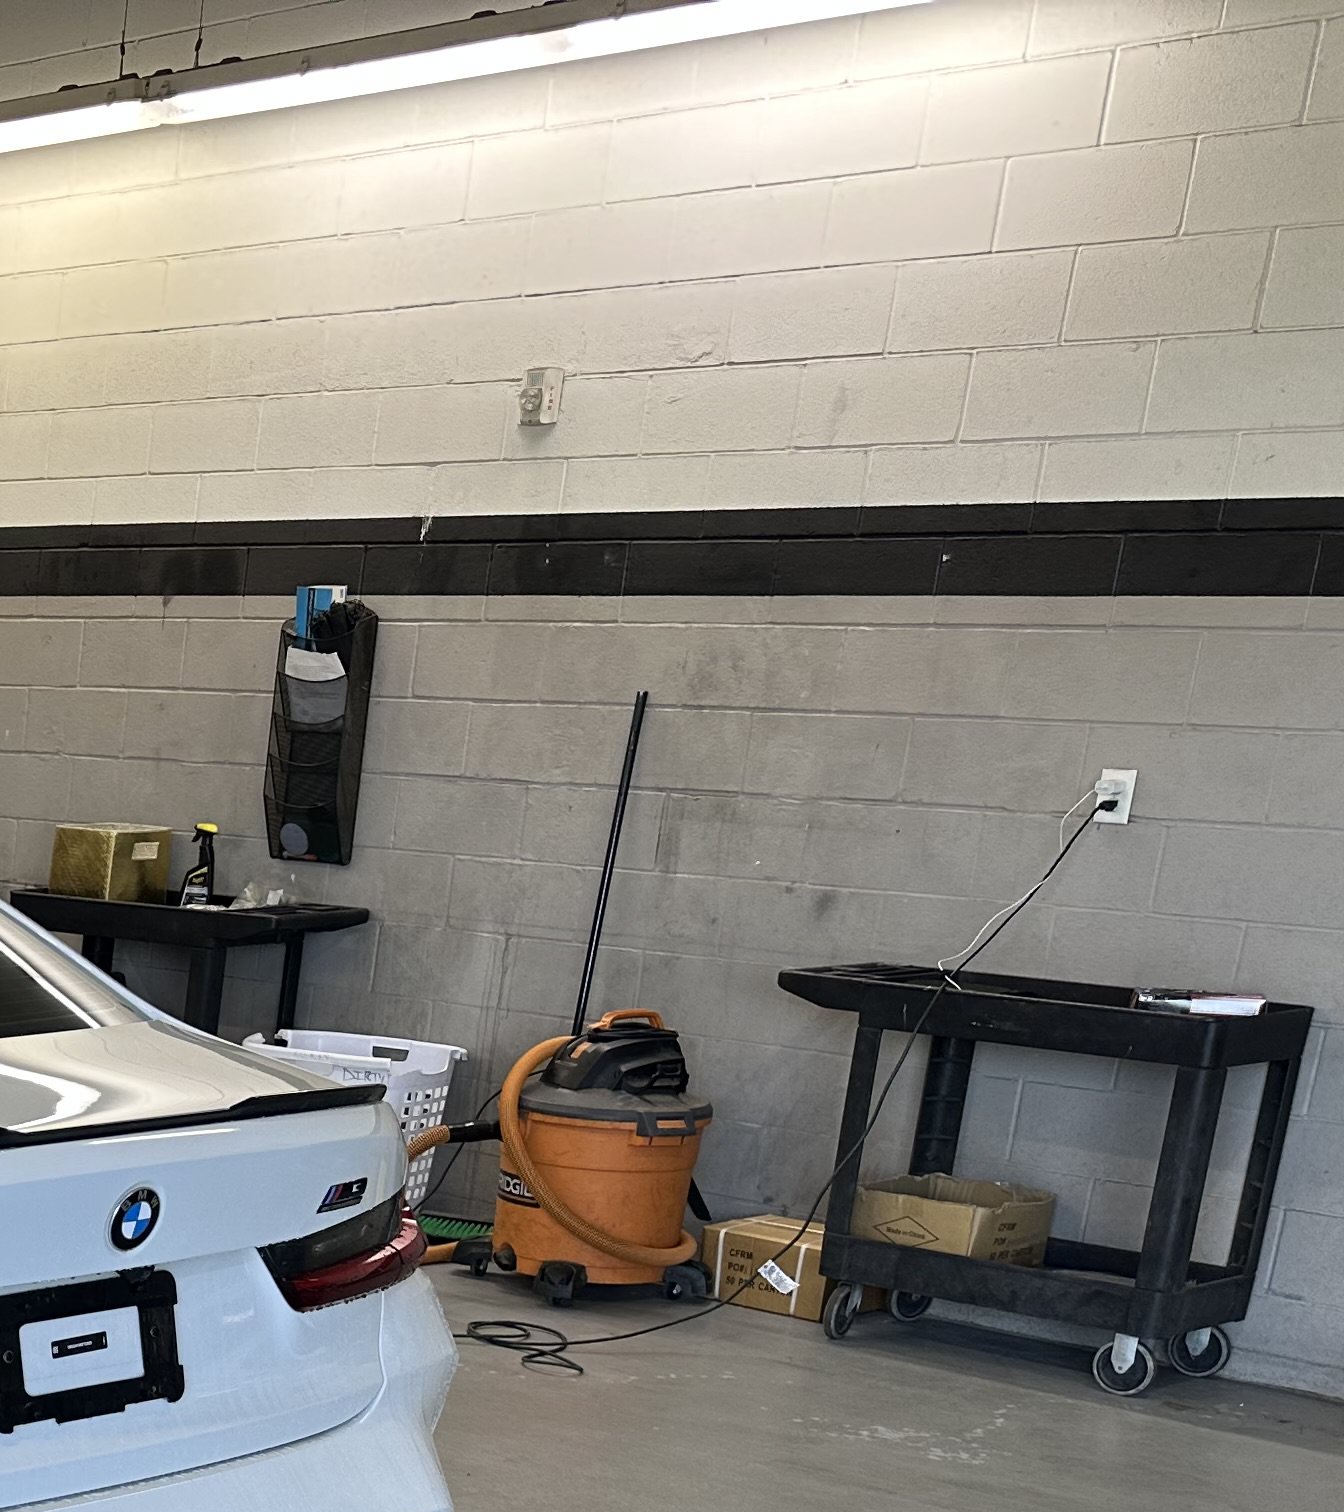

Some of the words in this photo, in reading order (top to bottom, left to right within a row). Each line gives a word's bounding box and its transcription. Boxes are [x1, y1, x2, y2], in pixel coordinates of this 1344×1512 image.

[342, 1067, 385, 1084] DIRTY
[120, 1189, 159, 1211] BMW
[729, 1248, 754, 1260] CFRM
